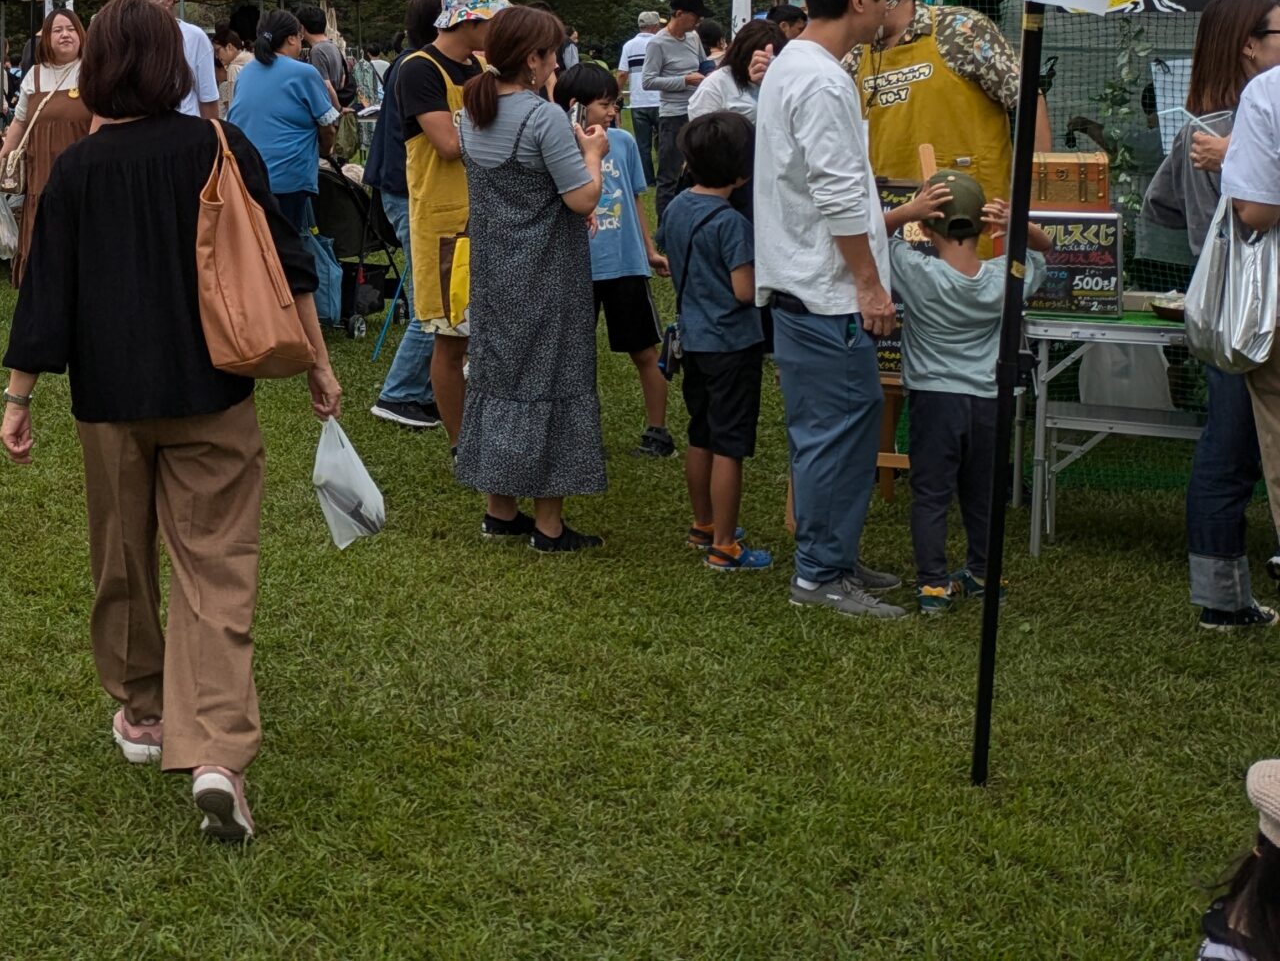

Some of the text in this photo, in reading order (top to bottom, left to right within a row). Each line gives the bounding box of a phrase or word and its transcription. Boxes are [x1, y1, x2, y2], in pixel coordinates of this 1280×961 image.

[598, 218, 621, 230] UCK
[1039, 224, 1116, 246] クレスくじ
